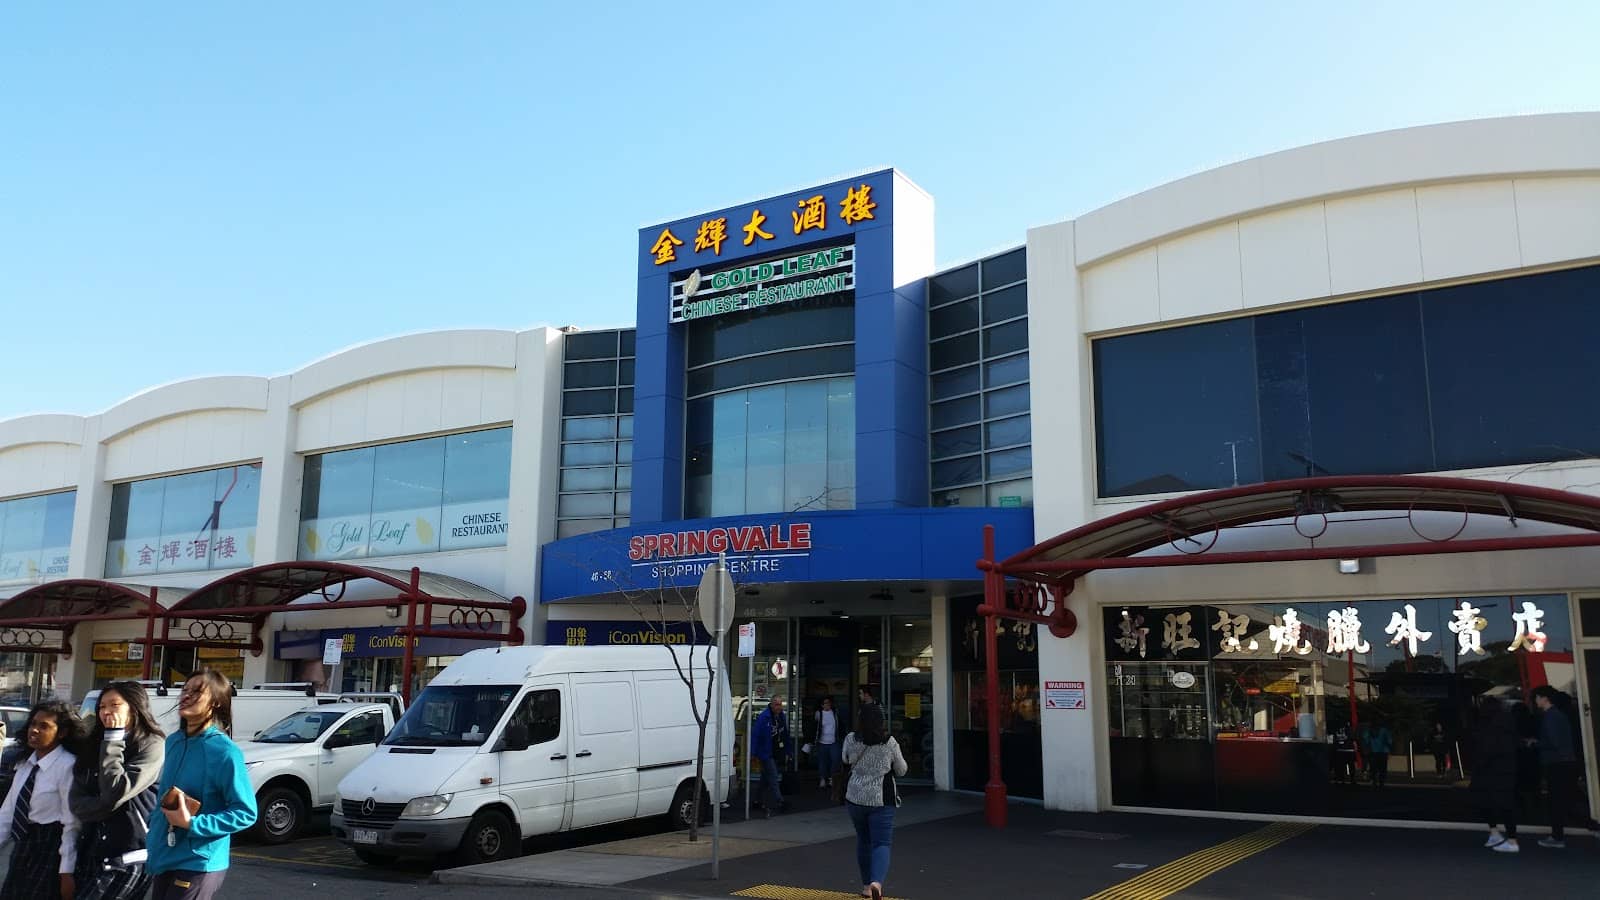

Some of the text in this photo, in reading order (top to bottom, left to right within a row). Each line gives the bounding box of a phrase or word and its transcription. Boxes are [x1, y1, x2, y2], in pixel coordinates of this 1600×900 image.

[651, 184, 877, 265] 金輝大酒樓
[711, 247, 844, 290] GOLD LEAF
[682, 272, 848, 320] CHINESE RESTAURANT
[371, 519, 410, 545] Leaf
[462, 512, 502, 525] CHINESE
[137, 535, 238, 567] 金輝酒樓
[628, 522, 812, 561] SPRINGVALE
[651, 563, 707, 578] SHOPPIN
[369, 634, 419, 648] iConVisin
[608, 630, 686, 644] iConVision
